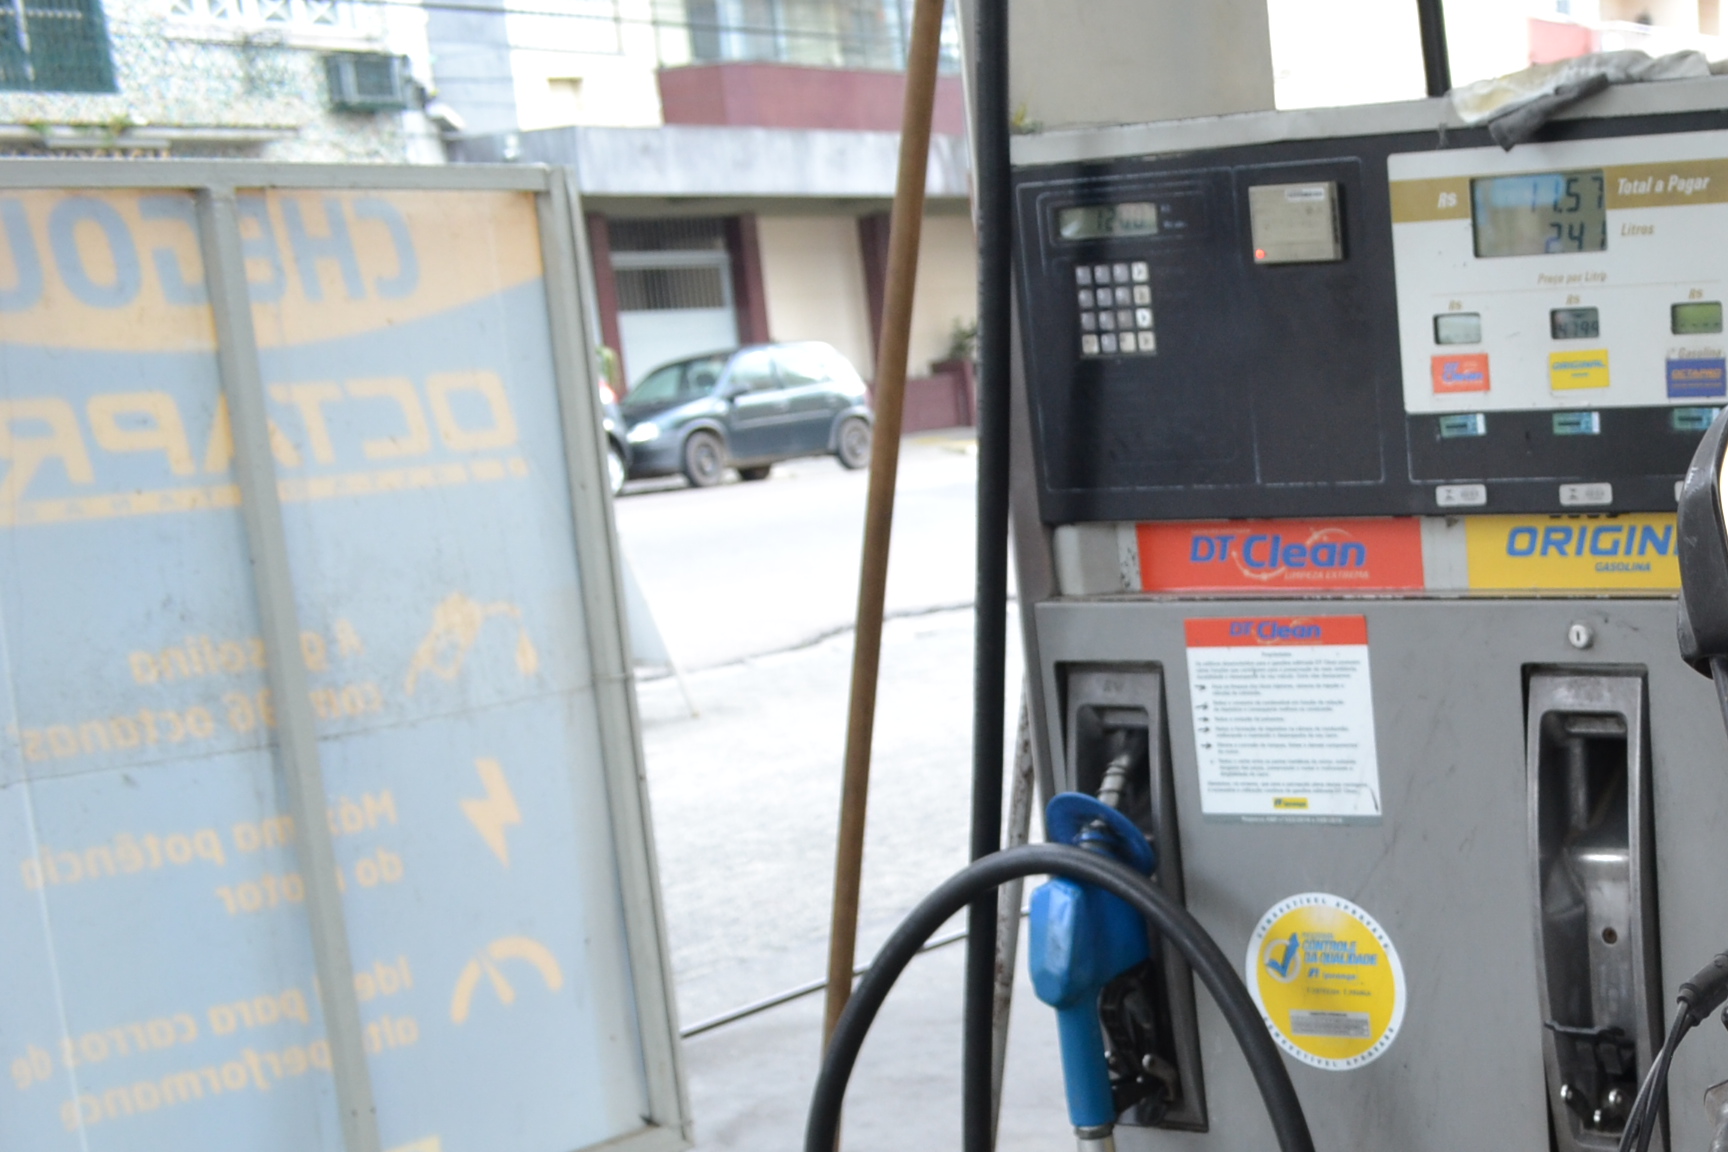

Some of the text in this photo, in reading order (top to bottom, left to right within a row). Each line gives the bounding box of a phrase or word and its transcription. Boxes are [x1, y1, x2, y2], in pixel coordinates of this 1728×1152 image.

[1618, 175, 1710, 195] Total a Pagar
[1620, 222, 1655, 236] Litros
[1585, 270, 1607, 283] Litro
[1506, 524, 1679, 557] ORIGIN
[1189, 534, 1367, 569] DT Clean
[1595, 562, 1652, 572] GASOLINA
[1230, 621, 1322, 639] DT Clean
[1302, 938, 1357, 953] CONTROLE
[1320, 953, 1378, 966] QUALIDADE
